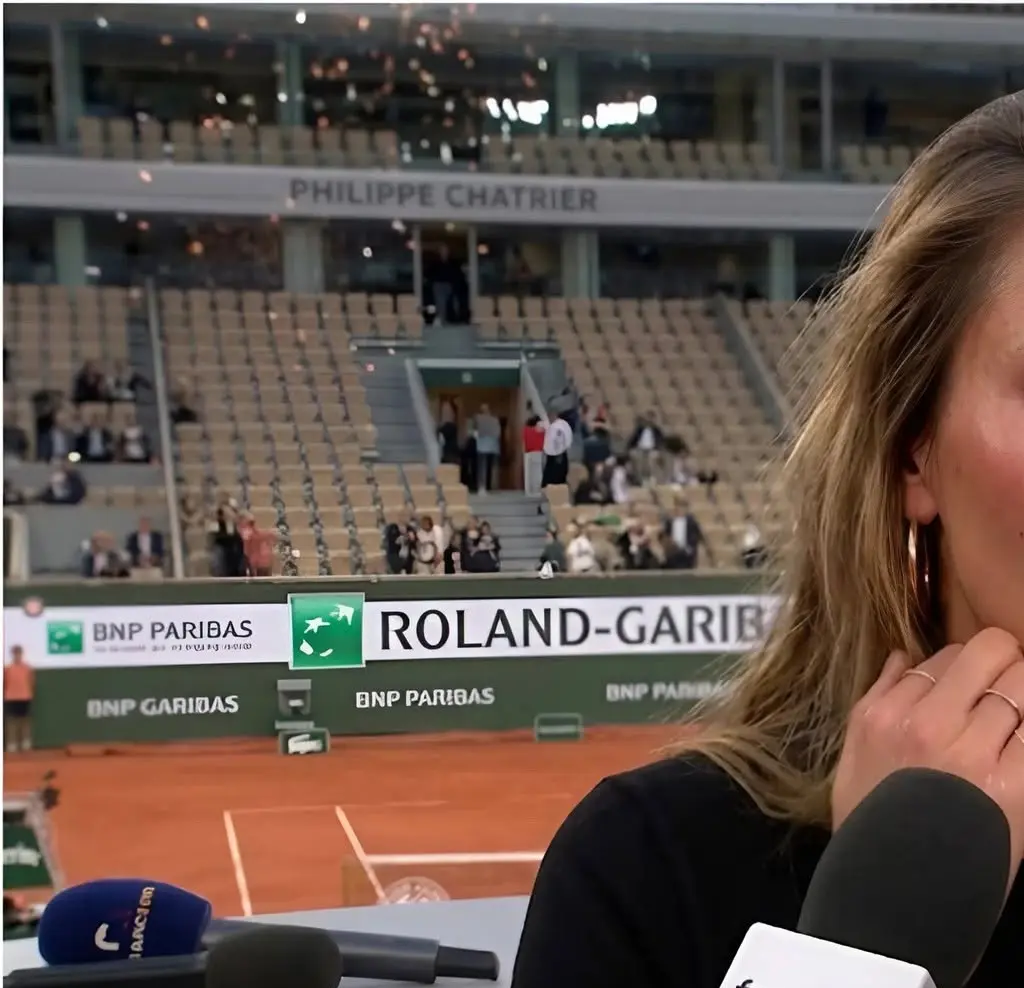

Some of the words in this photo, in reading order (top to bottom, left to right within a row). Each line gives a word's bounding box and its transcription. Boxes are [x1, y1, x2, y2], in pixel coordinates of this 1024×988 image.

[289, 178, 436, 207] PHILIPPE
[443, 182, 599, 212] CHATRIER
[93, 622, 143, 642] BNP
[356, 691, 401, 709] BNP
